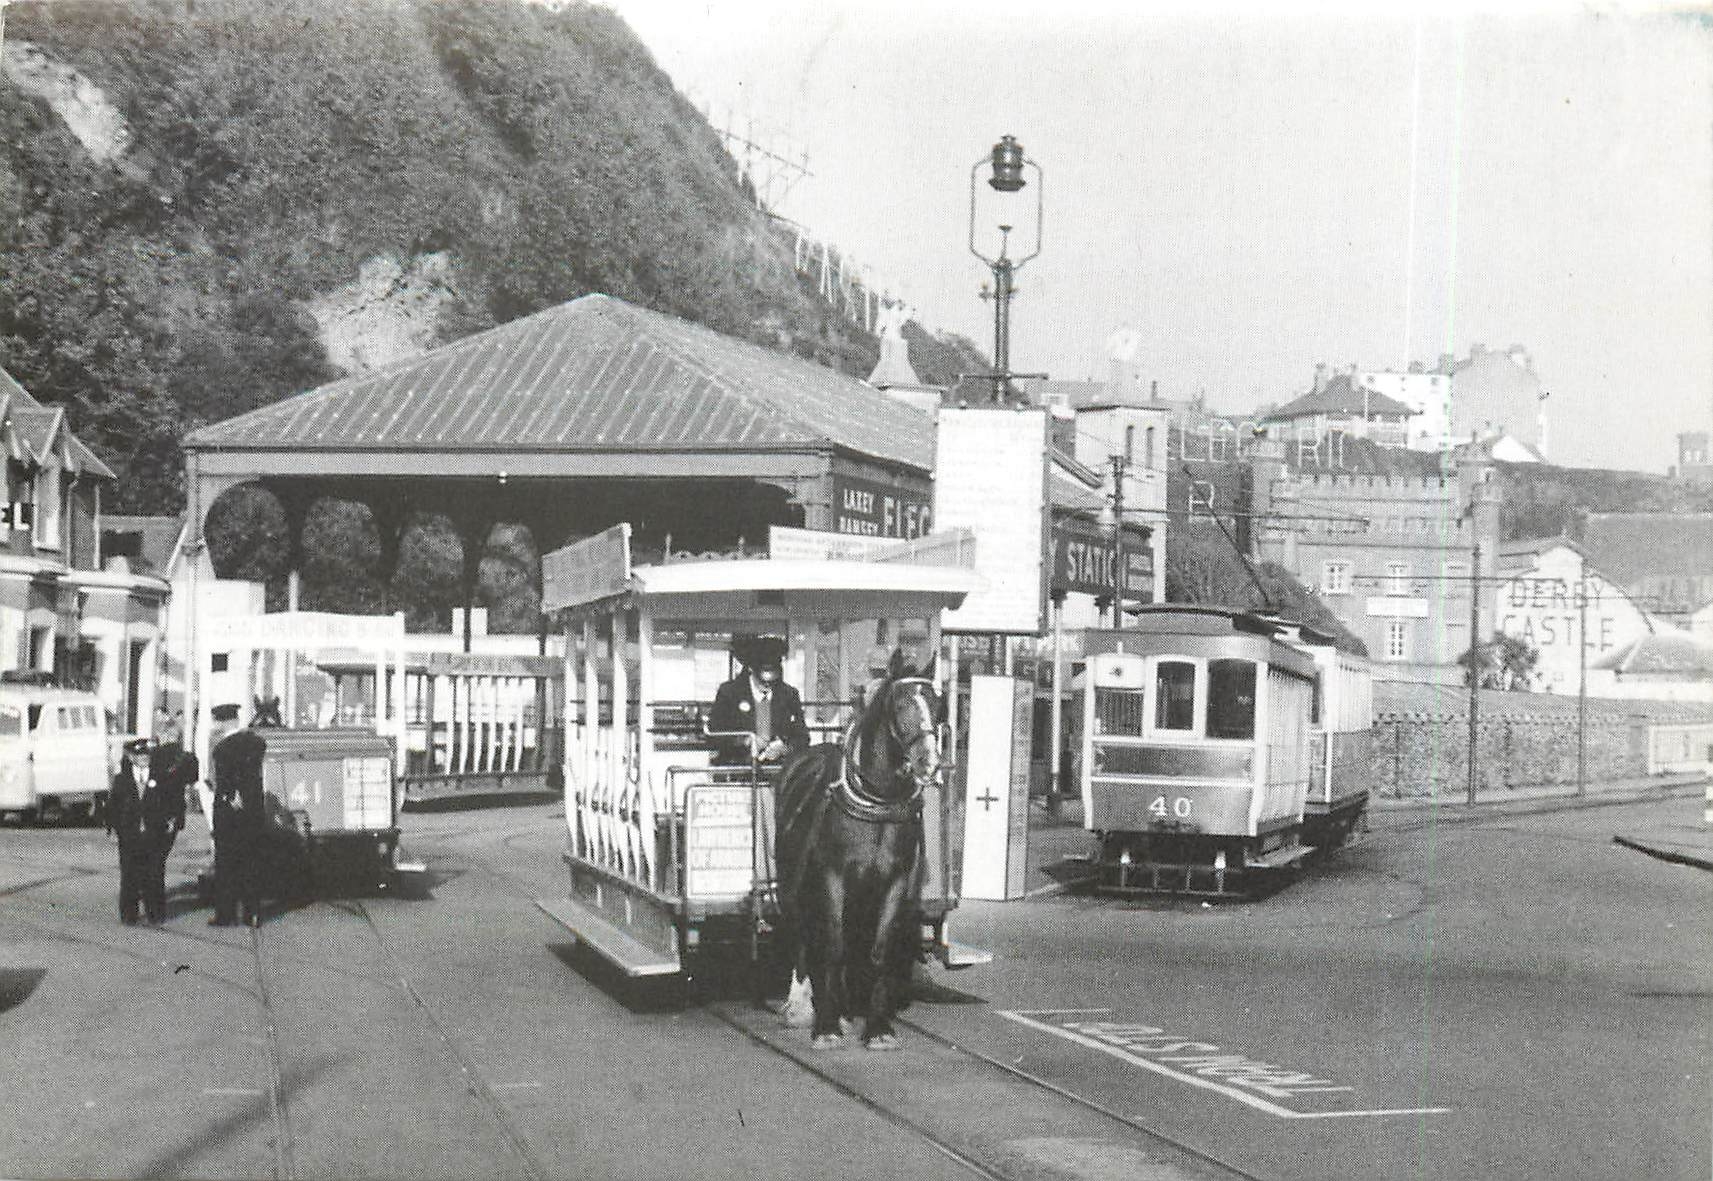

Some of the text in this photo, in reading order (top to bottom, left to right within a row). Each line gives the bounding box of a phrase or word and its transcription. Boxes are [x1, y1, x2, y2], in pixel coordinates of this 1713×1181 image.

[843, 487, 875, 514] LAXEY
[1509, 579, 1605, 609] DERBY
[291, 781, 321, 804] 41
[1147, 796, 1193, 817] 40
[1062, 1022, 1221, 1052] STOP
